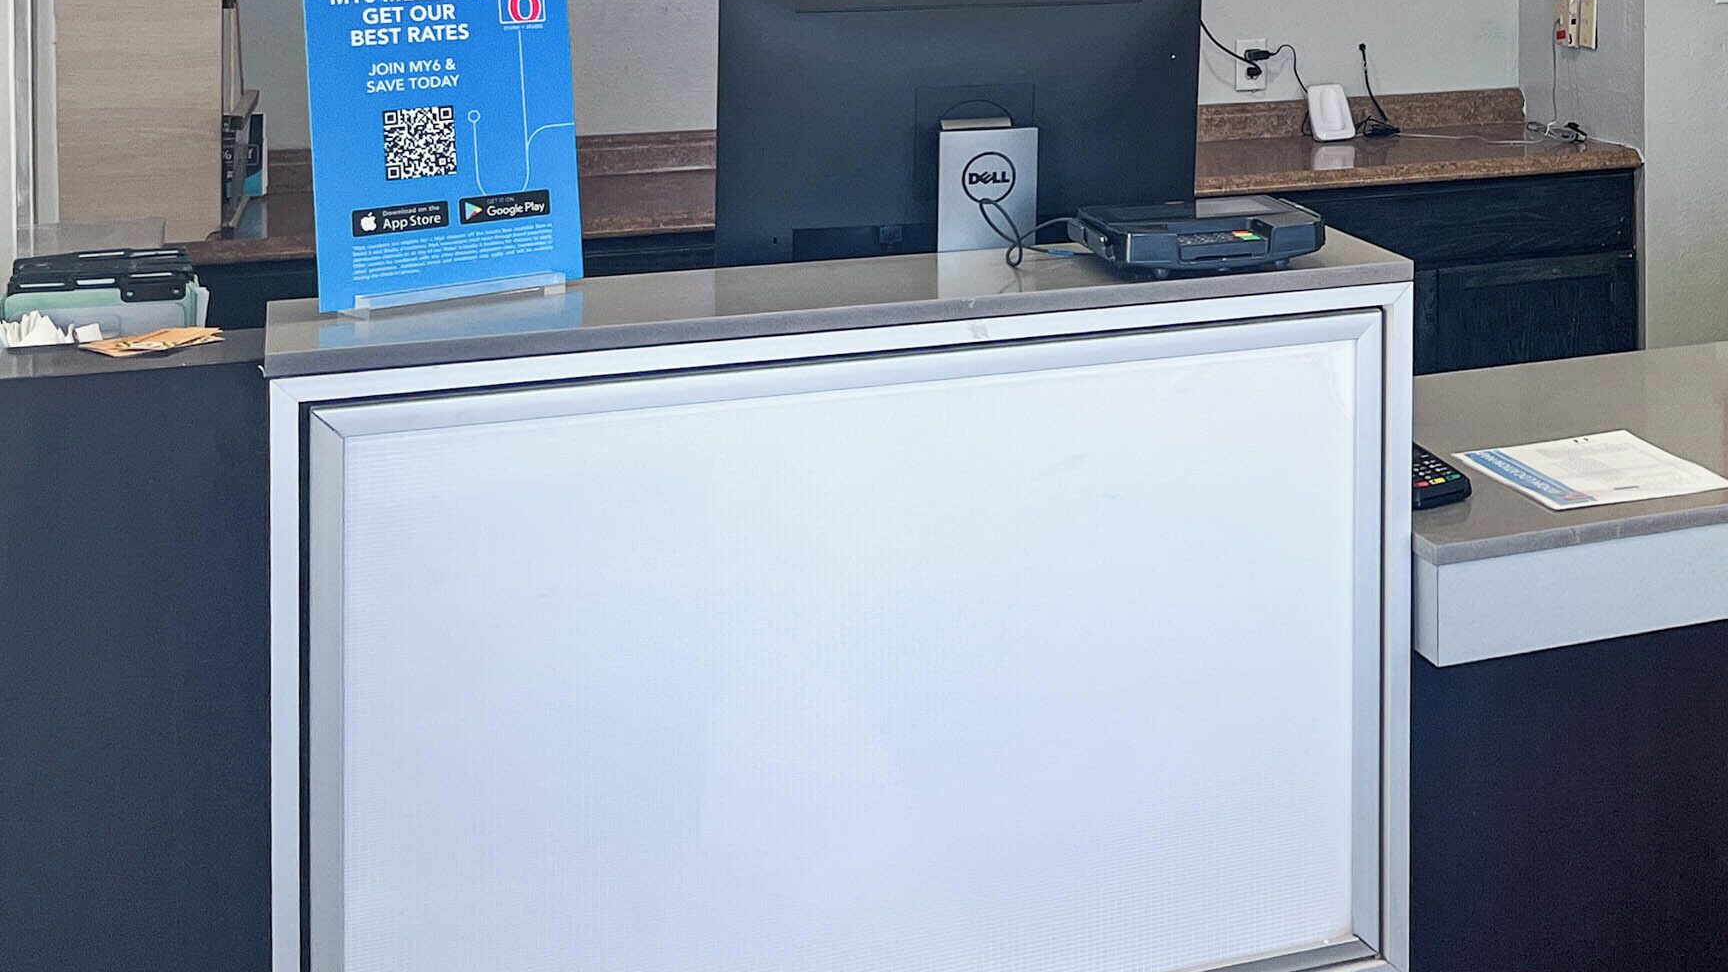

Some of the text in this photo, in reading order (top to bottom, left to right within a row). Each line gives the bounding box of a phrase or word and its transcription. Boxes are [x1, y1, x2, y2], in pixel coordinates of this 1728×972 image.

[362, 4, 456, 25] GET OUR
[351, 23, 470, 47] BEST RATES
[368, 58, 456, 76] JOIN MY6 &
[367, 75, 460, 93] SAVE TODAY
[968, 171, 1010, 185] DELL
[382, 207, 416, 217] Download
[486, 201, 545, 217] Google Play
[383, 213, 441, 230] App Store
